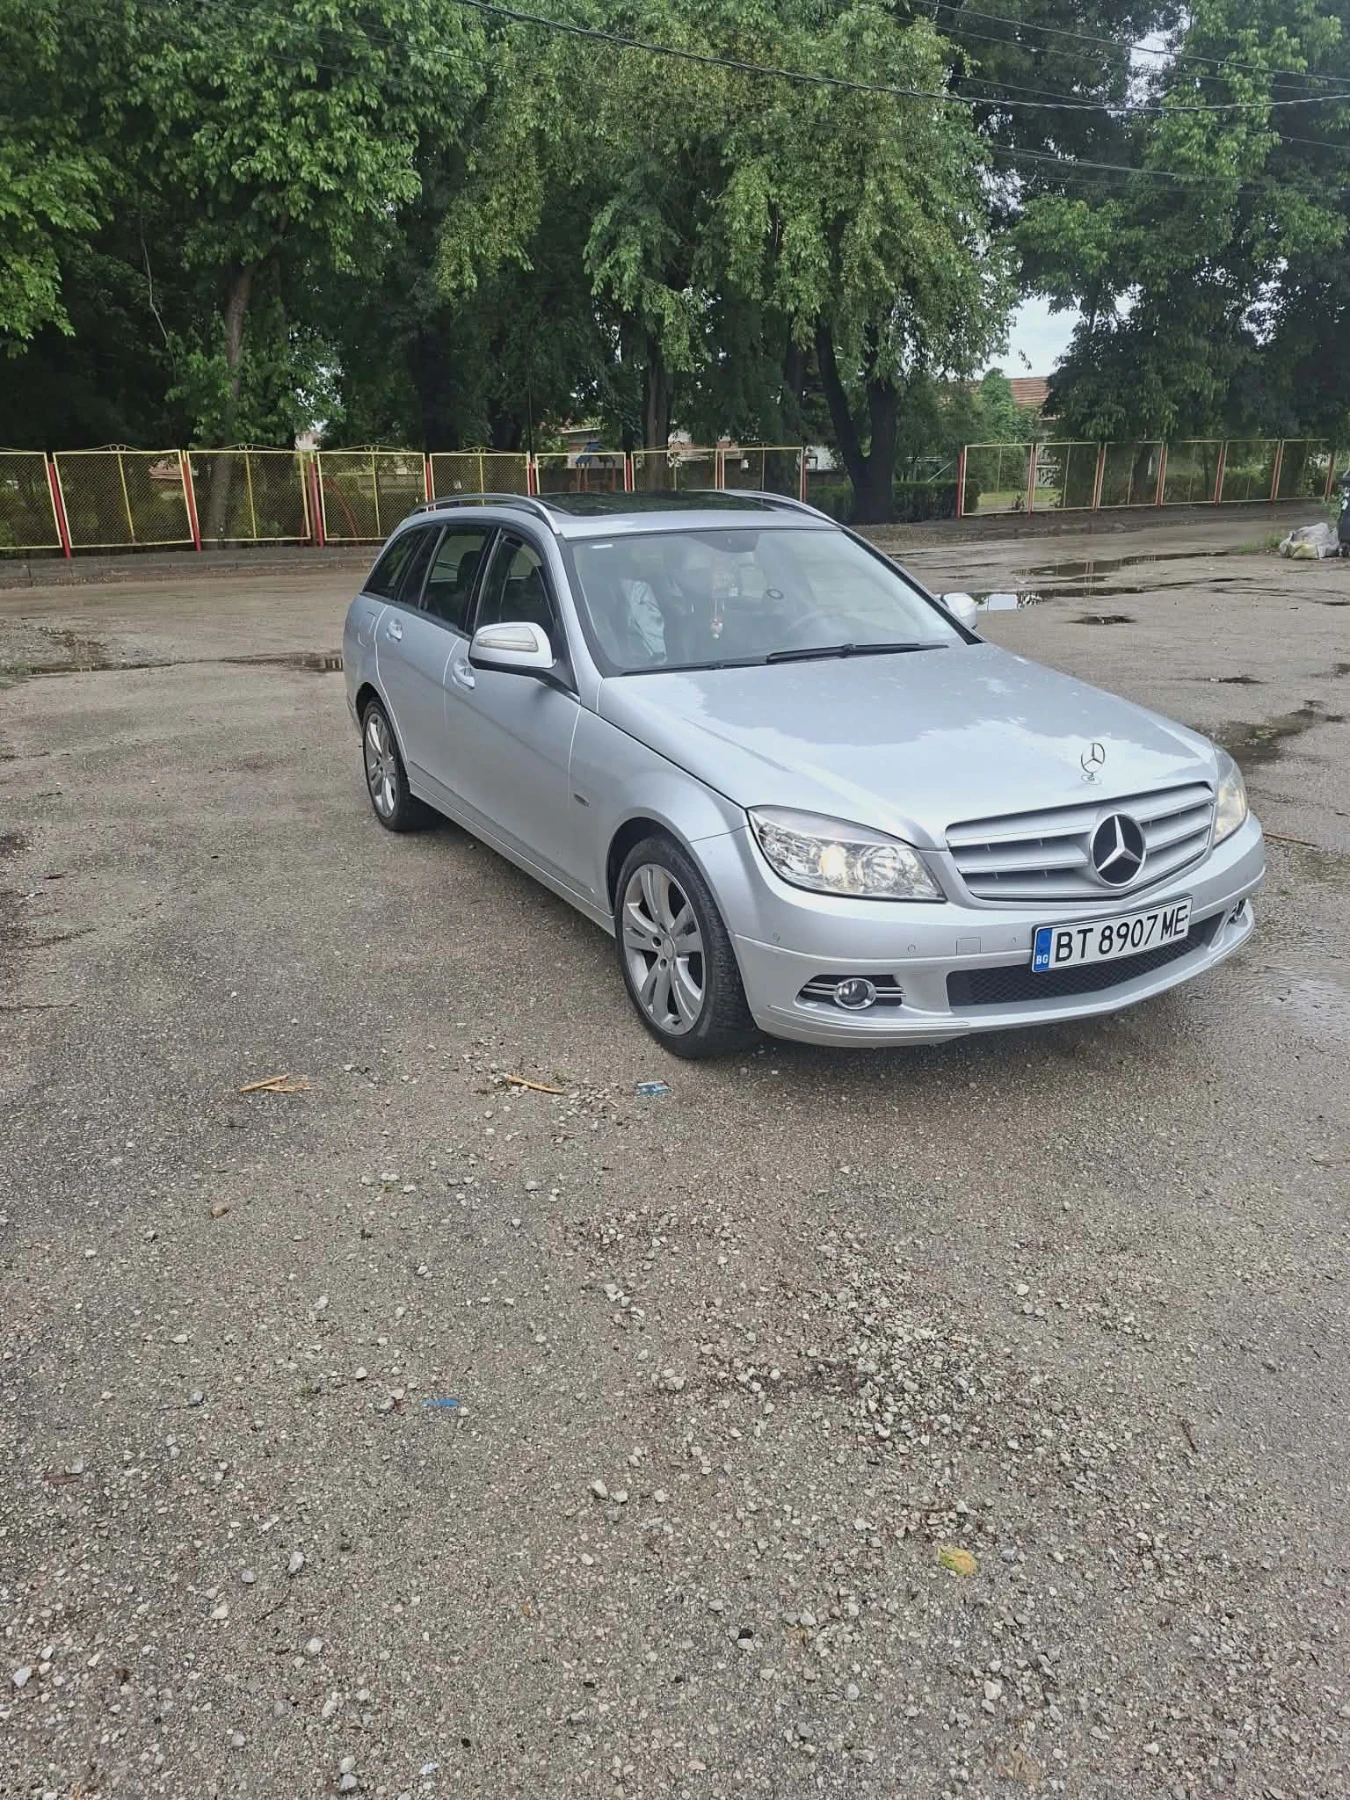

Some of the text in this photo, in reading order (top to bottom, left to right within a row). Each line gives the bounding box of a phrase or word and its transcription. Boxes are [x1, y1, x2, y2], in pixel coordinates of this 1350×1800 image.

[1055, 904, 1189, 963] BT 8907 ME
[1036, 954, 1049, 965] BG
